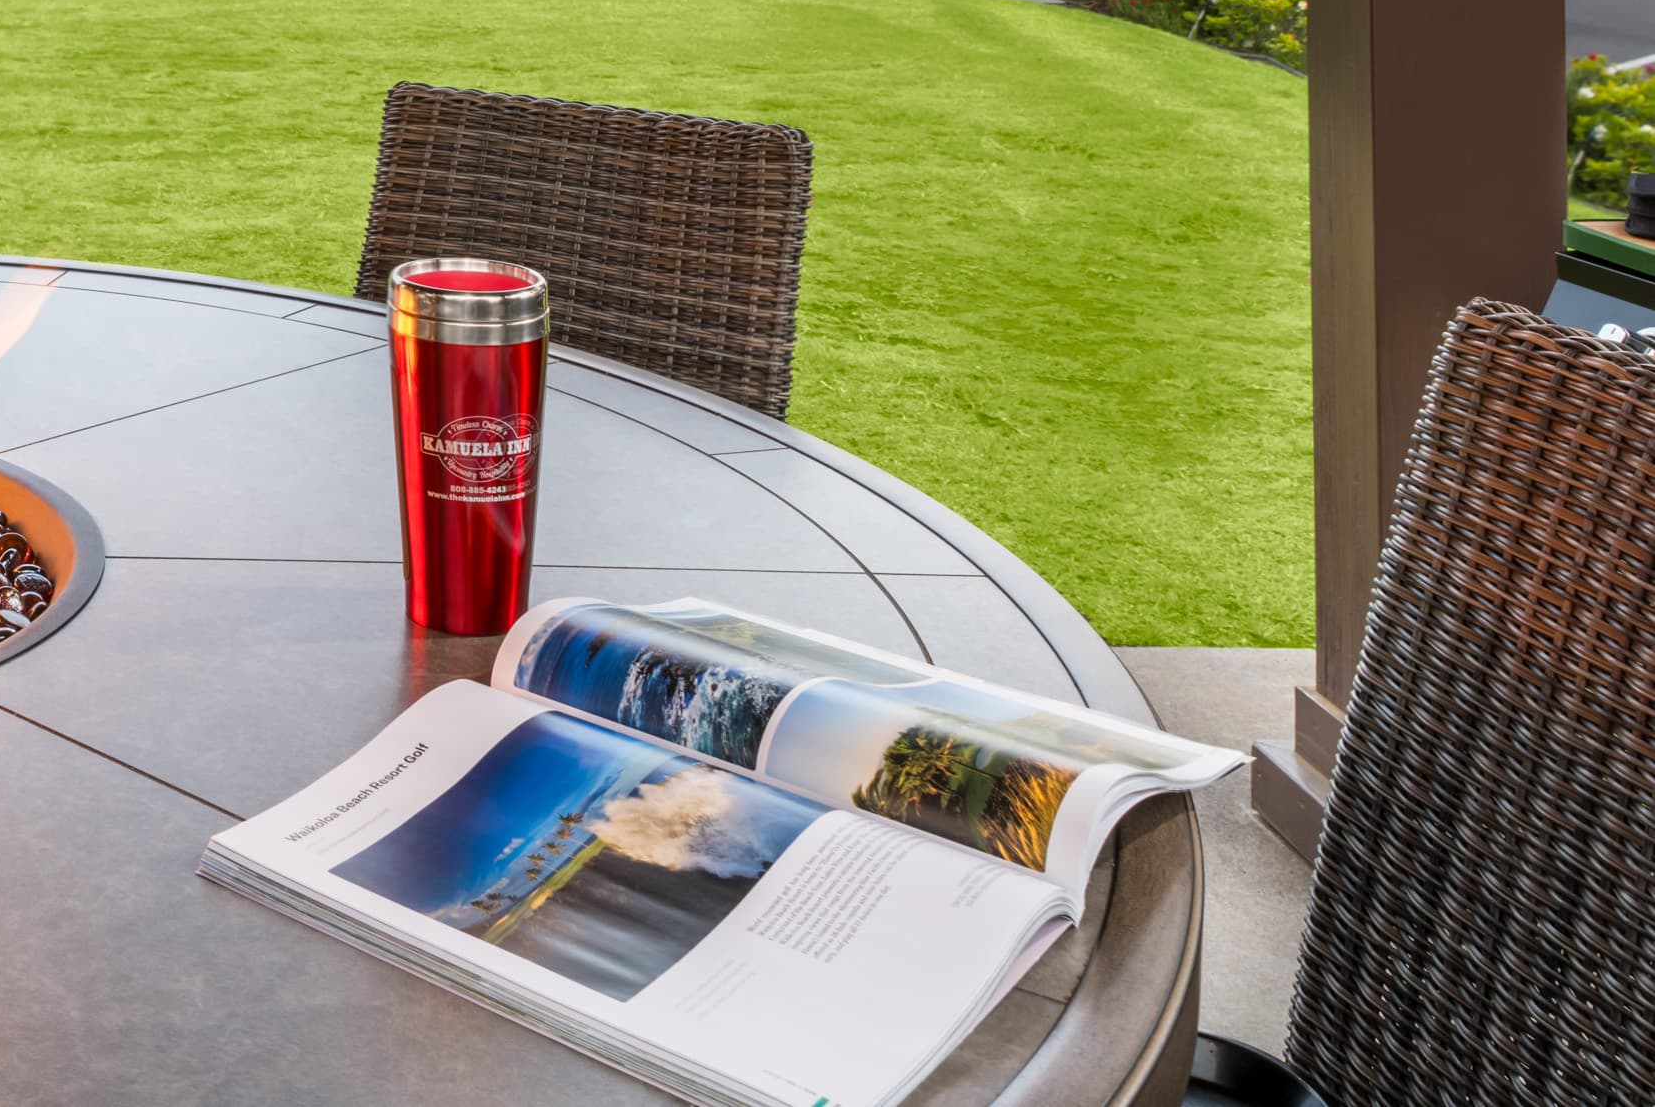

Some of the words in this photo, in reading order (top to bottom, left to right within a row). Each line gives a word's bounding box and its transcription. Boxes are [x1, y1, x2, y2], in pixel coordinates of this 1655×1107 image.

[423, 435, 504, 457] KAMUELA
[506, 437, 531, 455] INN
[284, 811, 340, 843] Waikoloa
[336, 789, 374, 813] Beach
[369, 762, 408, 790] Resort
[403, 742, 430, 764] Golf
